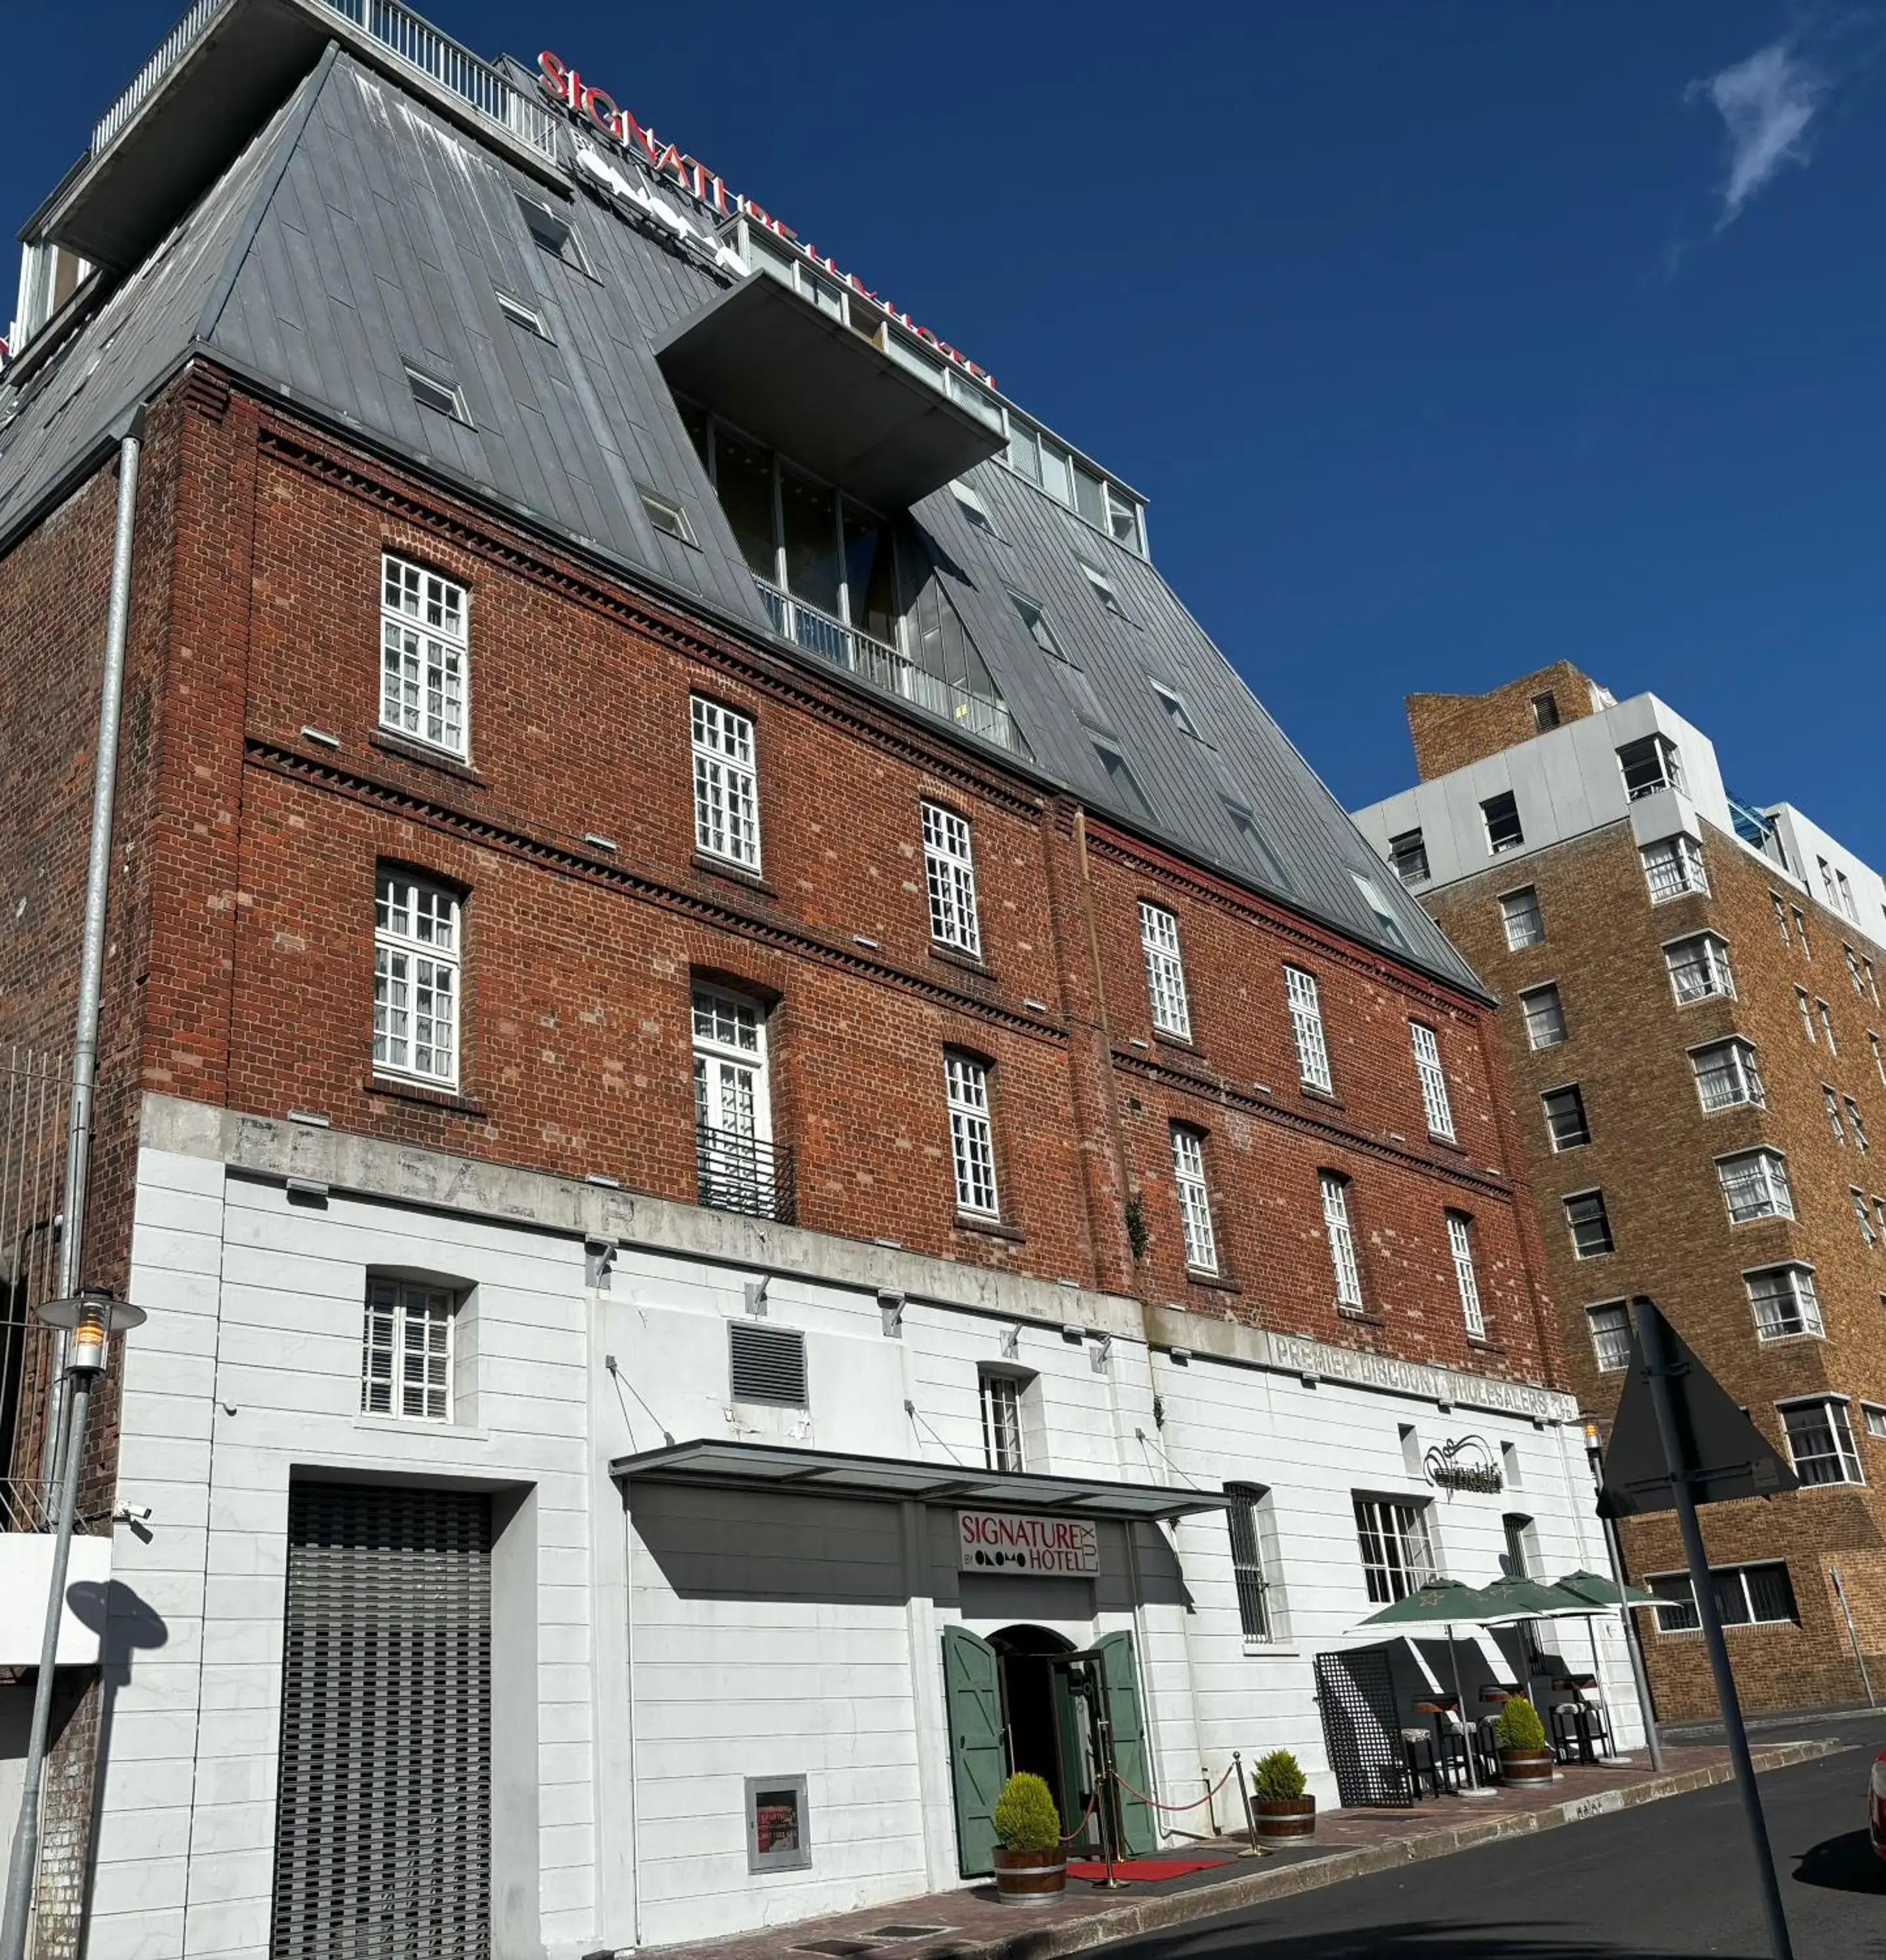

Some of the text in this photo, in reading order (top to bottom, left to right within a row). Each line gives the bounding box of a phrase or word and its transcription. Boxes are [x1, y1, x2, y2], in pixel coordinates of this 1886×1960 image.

[538, 50, 798, 239] SIGNATU
[1276, 1336, 1355, 1379] PREMIER
[961, 1515, 1084, 1549] SIGNATURE
[1029, 1548, 1085, 1571] HOTEL
